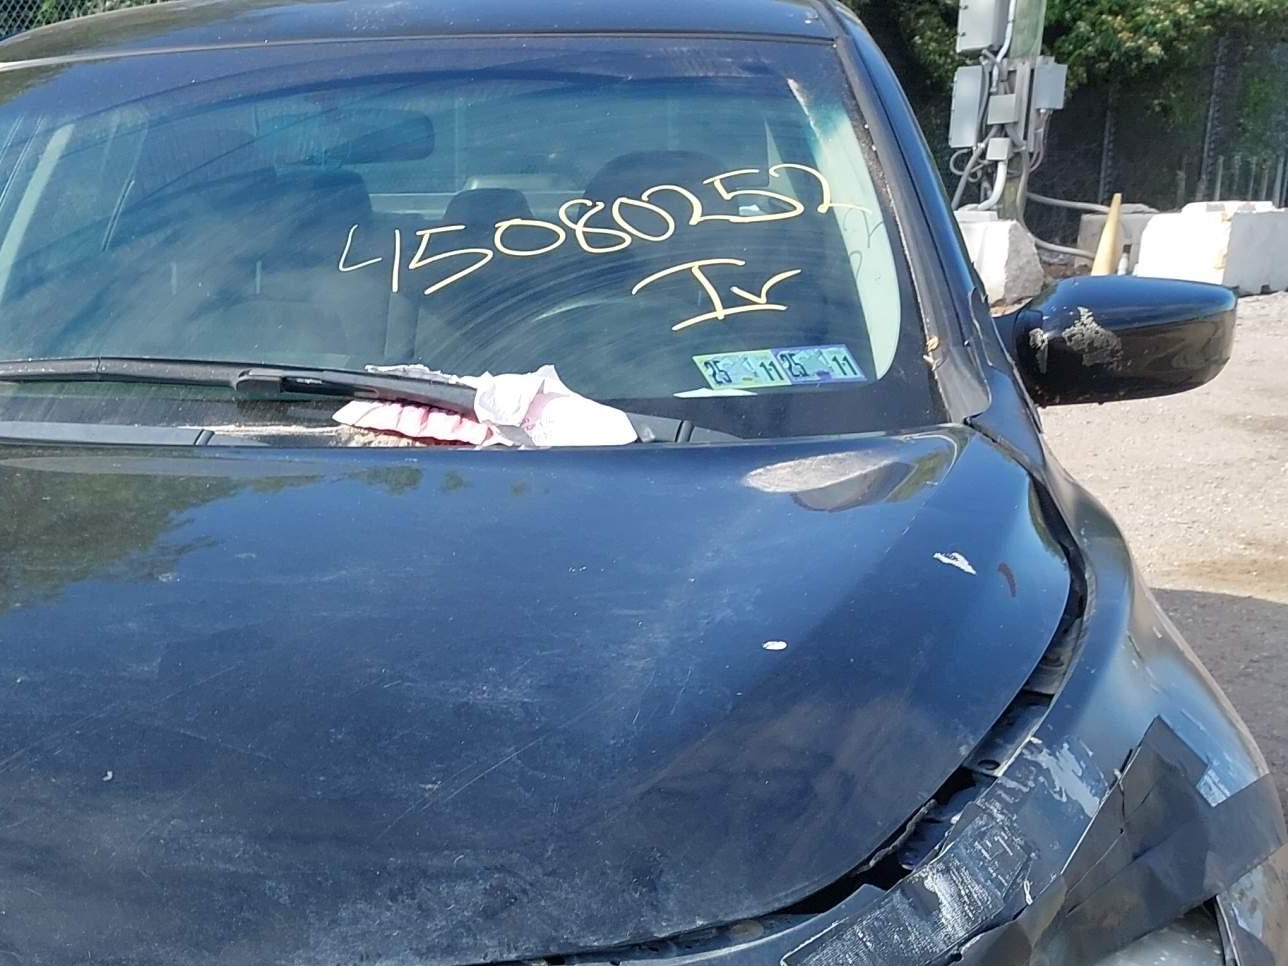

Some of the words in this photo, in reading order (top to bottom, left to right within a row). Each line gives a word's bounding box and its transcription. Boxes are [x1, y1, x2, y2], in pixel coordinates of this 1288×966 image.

[339, 163, 872, 295] 45080252
[704, 360, 732, 385] 25
[780, 353, 809, 378] 25
